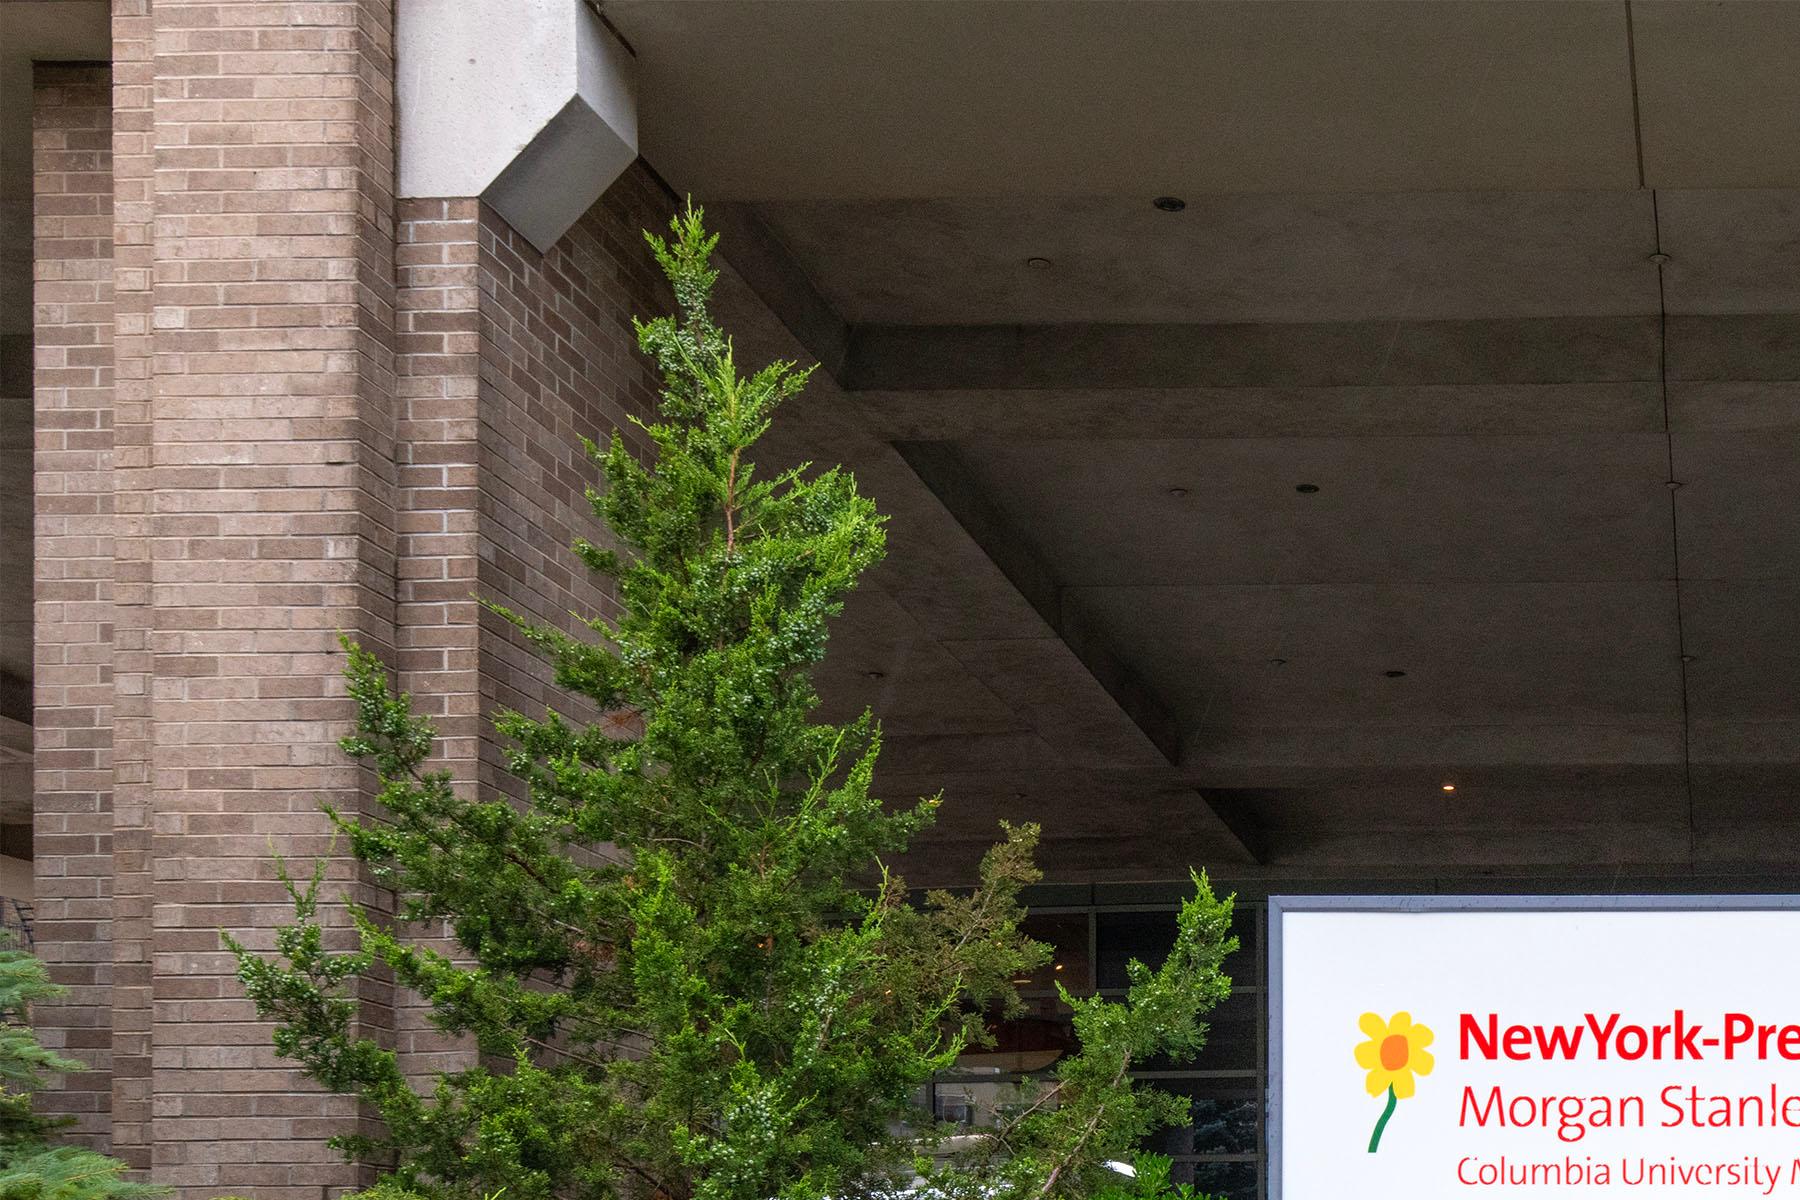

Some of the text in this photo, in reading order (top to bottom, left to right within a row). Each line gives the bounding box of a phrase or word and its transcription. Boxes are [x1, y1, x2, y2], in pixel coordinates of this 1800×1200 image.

[1458, 1085, 1645, 1143] Morgan
[1457, 1155, 1611, 1186] Columbia
[1622, 1155, 1781, 1196] University
